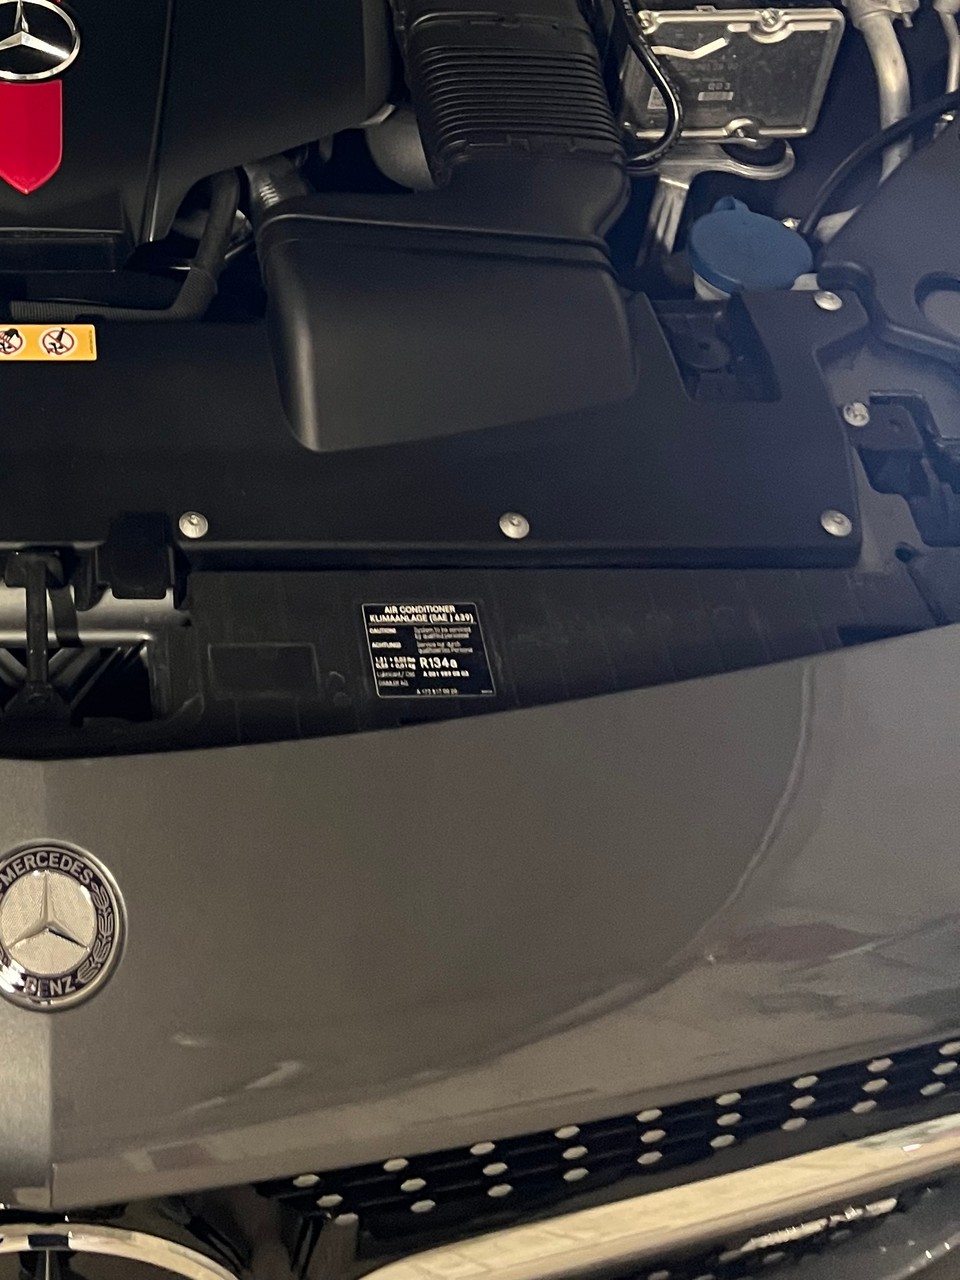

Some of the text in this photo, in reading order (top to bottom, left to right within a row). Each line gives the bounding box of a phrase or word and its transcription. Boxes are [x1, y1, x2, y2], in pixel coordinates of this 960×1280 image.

[384, 605, 456, 614] AIR CONDITIONER
[369, 614, 428, 623] KLIMAANLAGE
[419, 656, 458, 669] R134a
